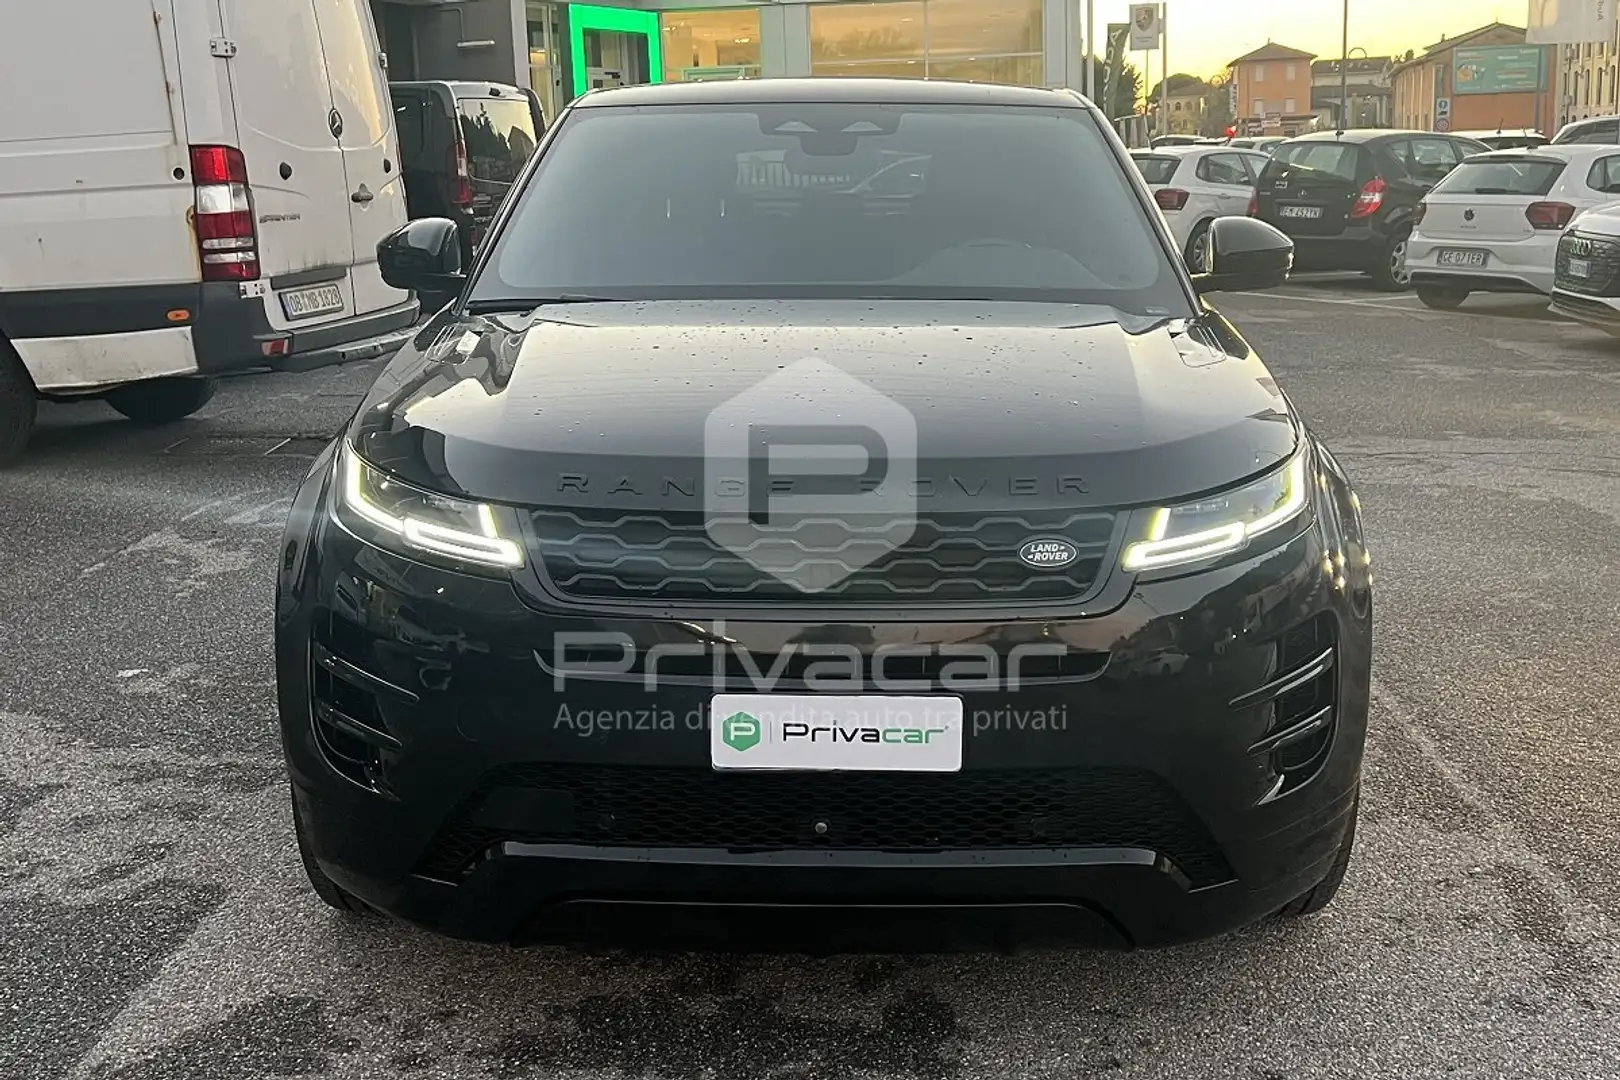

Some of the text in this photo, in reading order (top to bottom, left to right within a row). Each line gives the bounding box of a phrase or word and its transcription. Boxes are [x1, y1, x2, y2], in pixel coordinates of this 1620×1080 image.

[557, 473, 1089, 497] RANGE ROVER
[783, 720, 946, 744] Privacar
